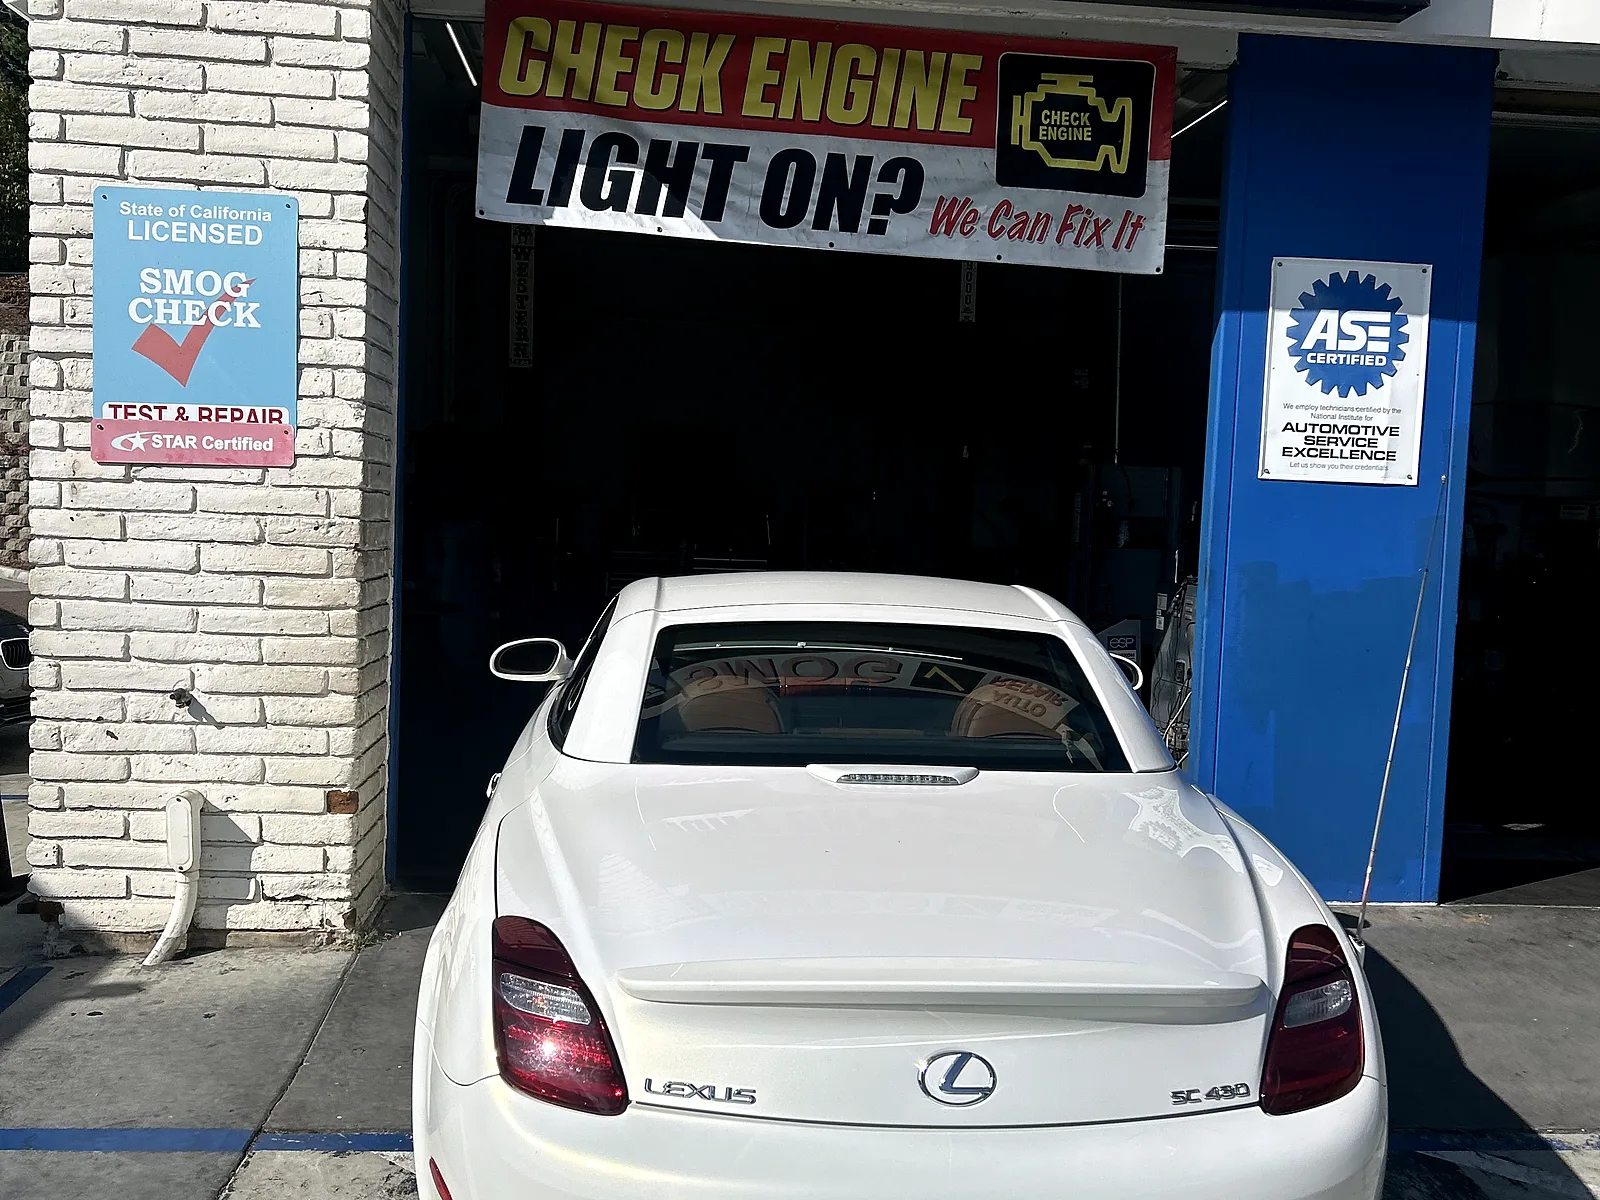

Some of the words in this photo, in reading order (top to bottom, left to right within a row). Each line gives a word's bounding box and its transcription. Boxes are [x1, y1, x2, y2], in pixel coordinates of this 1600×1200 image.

[498, 15, 737, 115] CHECK
[741, 36, 983, 134] ENGINE
[1041, 108, 1091, 127] CHECK
[1038, 124, 1092, 142] ENGINE
[505, 124, 752, 223] LIGHT
[758, 147, 926, 237] ON?
[119, 201, 162, 217] State
[166, 202, 186, 218] of
[189, 203, 272, 222] California
[127, 219, 263, 246] LICENSED
[929, 195, 981, 239] We
[987, 198, 1053, 244] Can
[1055, 203, 1114, 248] Fix
[1111, 209, 1147, 252] It
[139, 267, 251, 298] SMOG
[128, 299, 261, 328] CHECK
[1300, 308, 1392, 353] ASE
[1306, 352, 1387, 367] CERTIFIED
[1282, 402, 1294, 410] We
[1295, 403, 1319, 412] employ
[1319, 404, 1356, 412] technicians
[1355, 405, 1381, 413] certified
[1382, 406, 1391, 414] by
[1338, 413, 1363, 421] Institute
[1364, 414, 1374, 422] for
[1281, 421, 1400, 437] AUTOMOTIVE
[151, 434, 198, 450] STAR
[201, 435, 274, 452] Certified
[1303, 435, 1379, 448] SERVICE
[1281, 446, 1397, 462] EXCELLENCE
[1327, 463, 1339, 471] you
[643, 1077, 758, 1106] LEXUS
[1168, 1088, 1202, 1106] SC
[1203, 1082, 1251, 1101] 430
